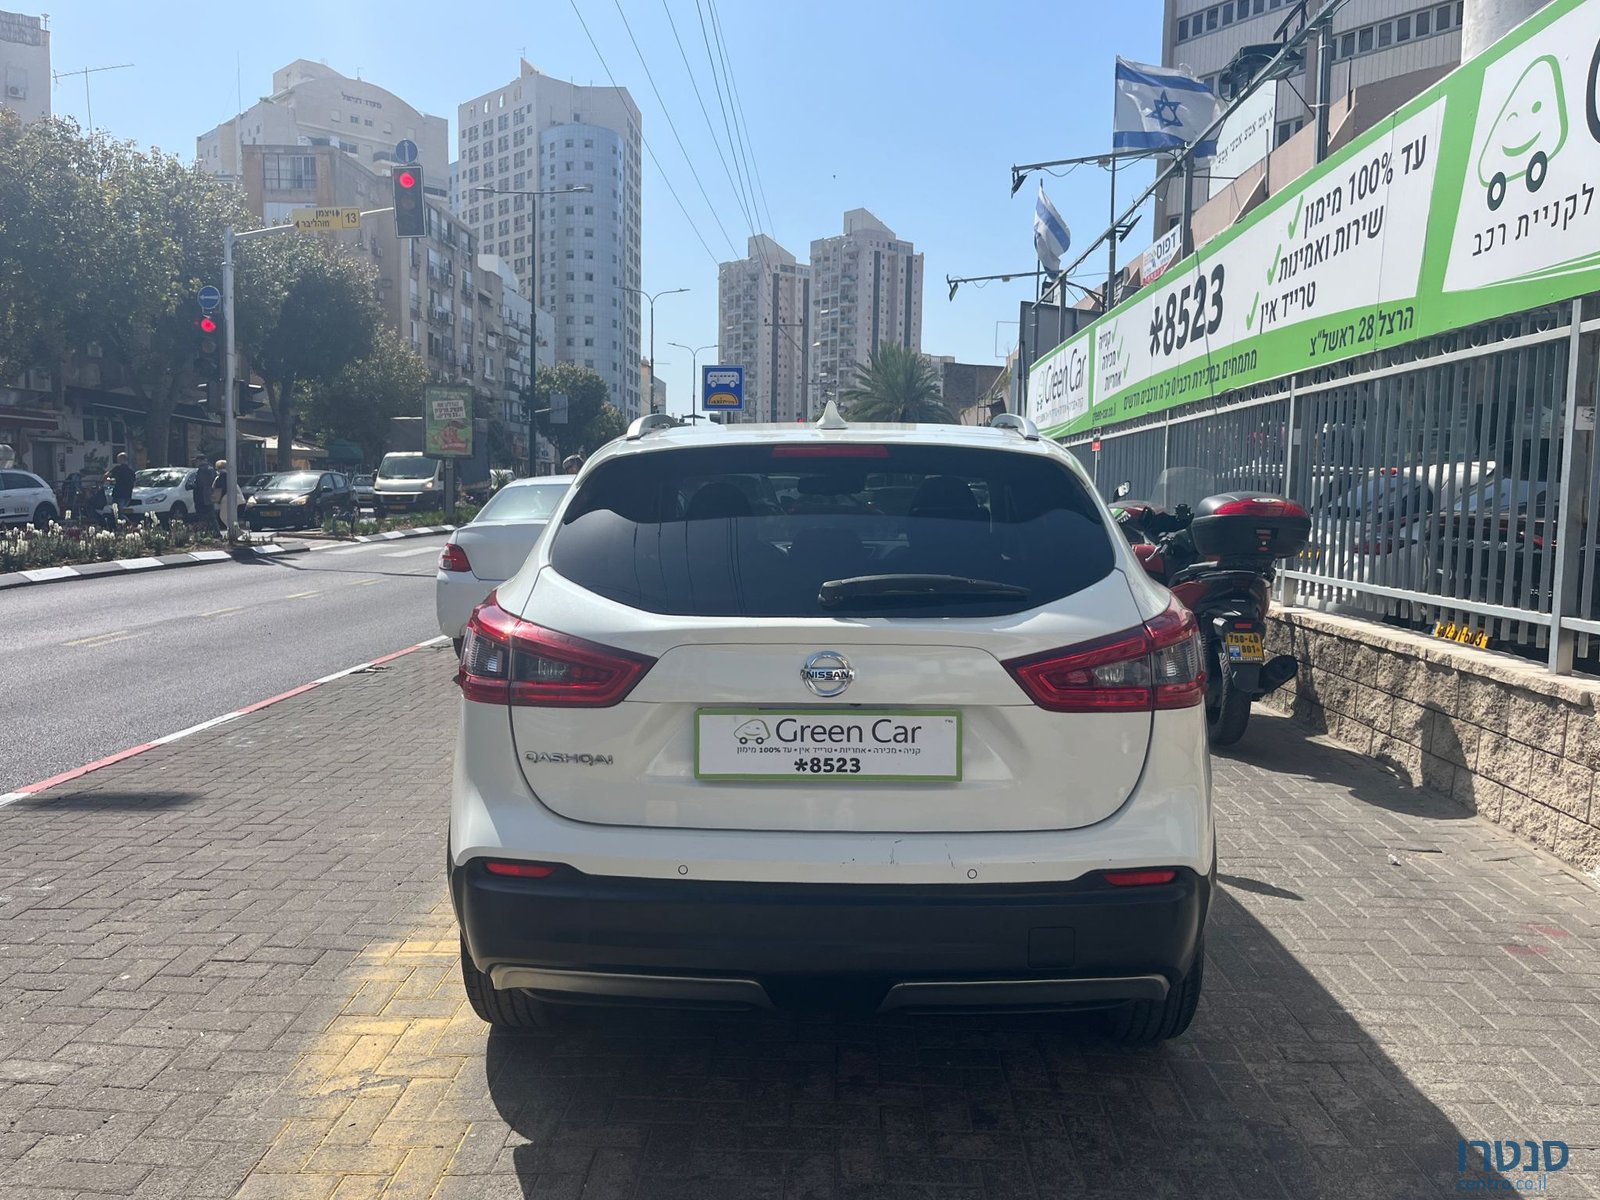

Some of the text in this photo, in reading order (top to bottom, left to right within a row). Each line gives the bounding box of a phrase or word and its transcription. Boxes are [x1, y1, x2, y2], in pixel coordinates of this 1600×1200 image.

[1303, 135, 1427, 239] עד 100% מימון
[345, 212, 357, 224] 13
[1472, 183, 1595, 256] לקניית רכב
[1156, 232, 1176, 260] דפוס
[1277, 205, 1385, 283] שירות ואמינות
[1259, 281, 1316, 335] טרייד אין
[1378, 306, 1414, 338] הרצל
[1357, 313, 1375, 344] 28
[1044, 348, 1087, 404] Green Car
[1221, 349, 1257, 379] מתמחים
[806, 670, 850, 679] NISSAN
[775, 718, 922, 743] Green Car
[524, 751, 614, 766] QASHQAI
[736, 746, 757, 754] מימון
[799, 746, 810, 754] אין
[838, 746, 866, 754] אחריות
